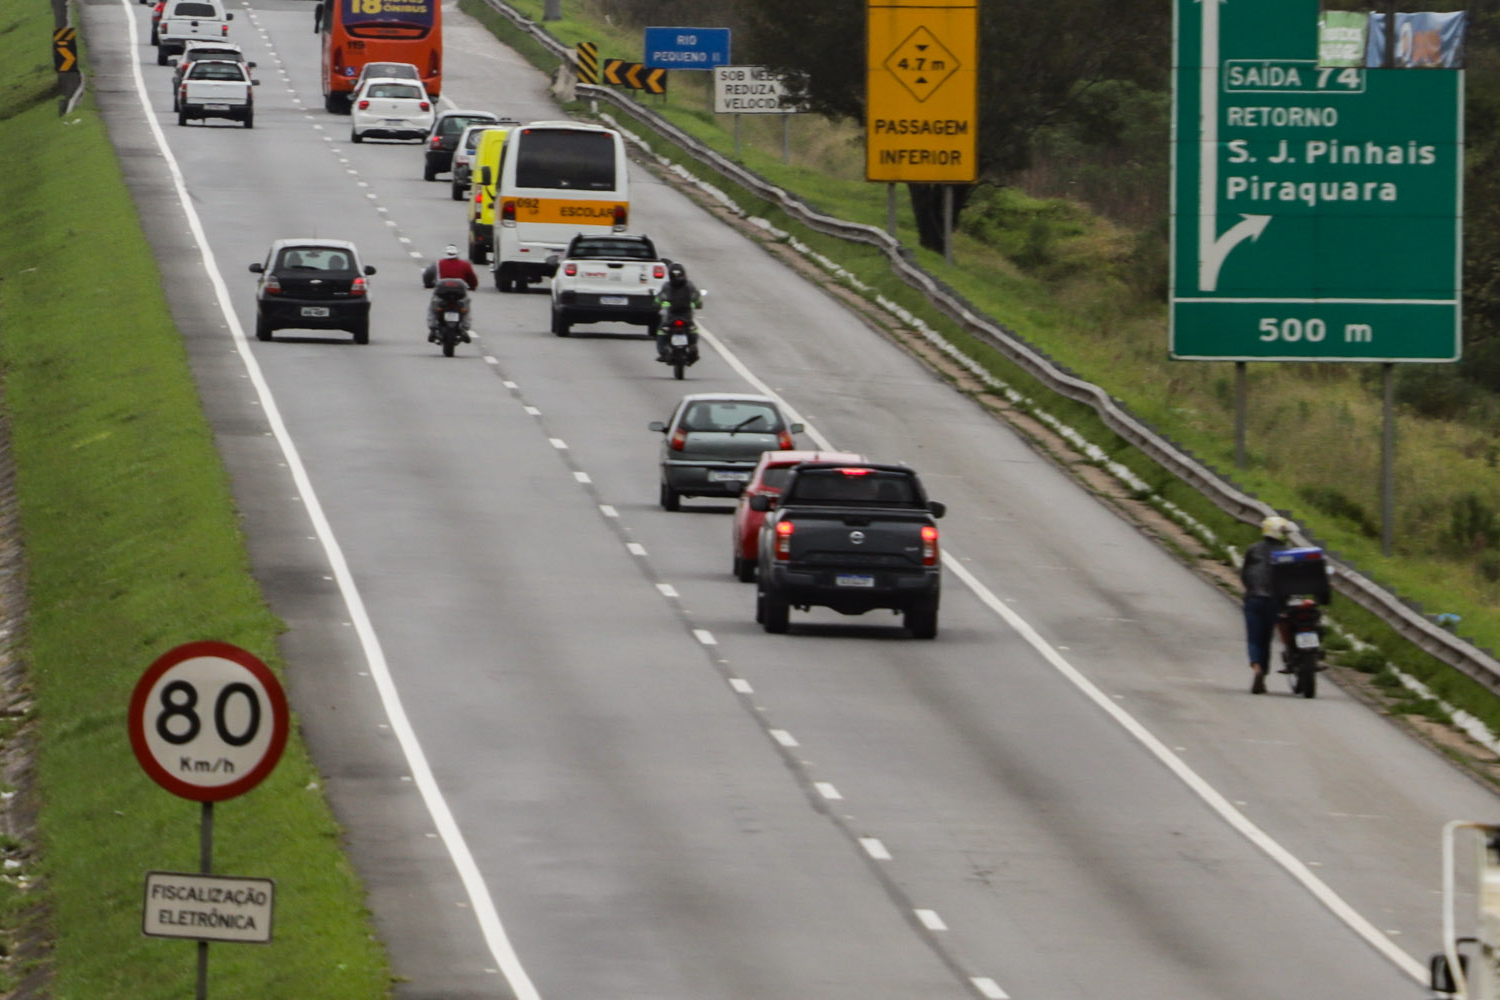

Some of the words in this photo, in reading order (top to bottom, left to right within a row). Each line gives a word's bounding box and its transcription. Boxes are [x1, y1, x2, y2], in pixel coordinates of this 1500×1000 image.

[383, 3, 428, 13] ÔNIBUS
[677, 35, 697, 45] RIO
[653, 52, 707, 62] PEQUENO
[898, 58, 926, 70] 4.7
[932, 60, 945, 70] m
[720, 71, 745, 81] SOB
[1229, 63, 1301, 86] SAÍDA
[1315, 68, 1361, 88] 74
[725, 84, 776, 95] REDUZA
[1227, 107, 1338, 126] RETORNO
[875, 119, 968, 135] PASSAGEM
[880, 150, 962, 165] INFERIOR
[1228, 140, 1257, 163] S.
[1268, 140, 1296, 163] J.
[1305, 140, 1436, 164] Pinhais
[1227, 175, 1397, 207] Piraquara
[1259, 319, 1327, 342] 500
[1345, 323, 1372, 342] m
[156, 680, 261, 747] 80
[180, 756, 235, 774] Km/h
[152, 884, 267, 908] FISCALIZAÇÃO
[159, 908, 257, 931] ELETRÔNICA
